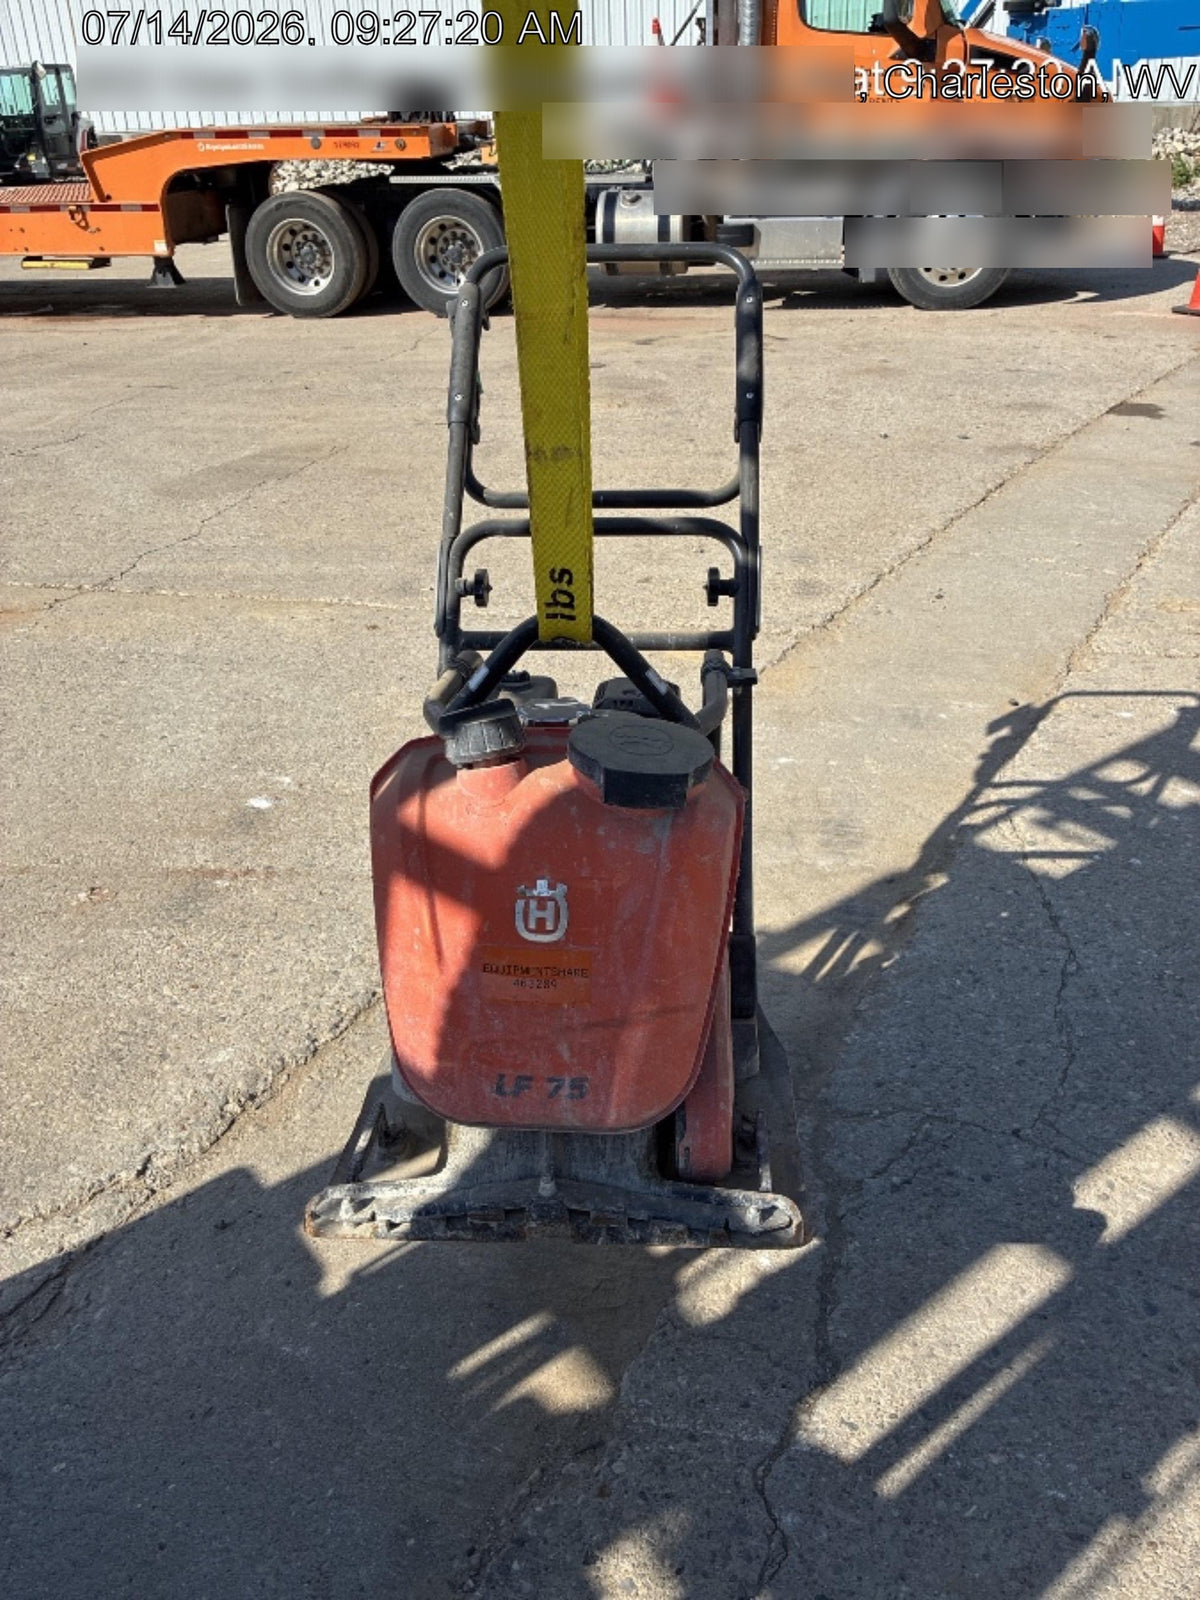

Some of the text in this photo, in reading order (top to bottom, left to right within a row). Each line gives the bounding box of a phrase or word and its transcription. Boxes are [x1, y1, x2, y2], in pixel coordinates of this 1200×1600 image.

[544, 567, 576, 621] lbs
[482, 963, 590, 978] EQUIPMNTSHARE
[496, 1073, 590, 1100] LF 75
